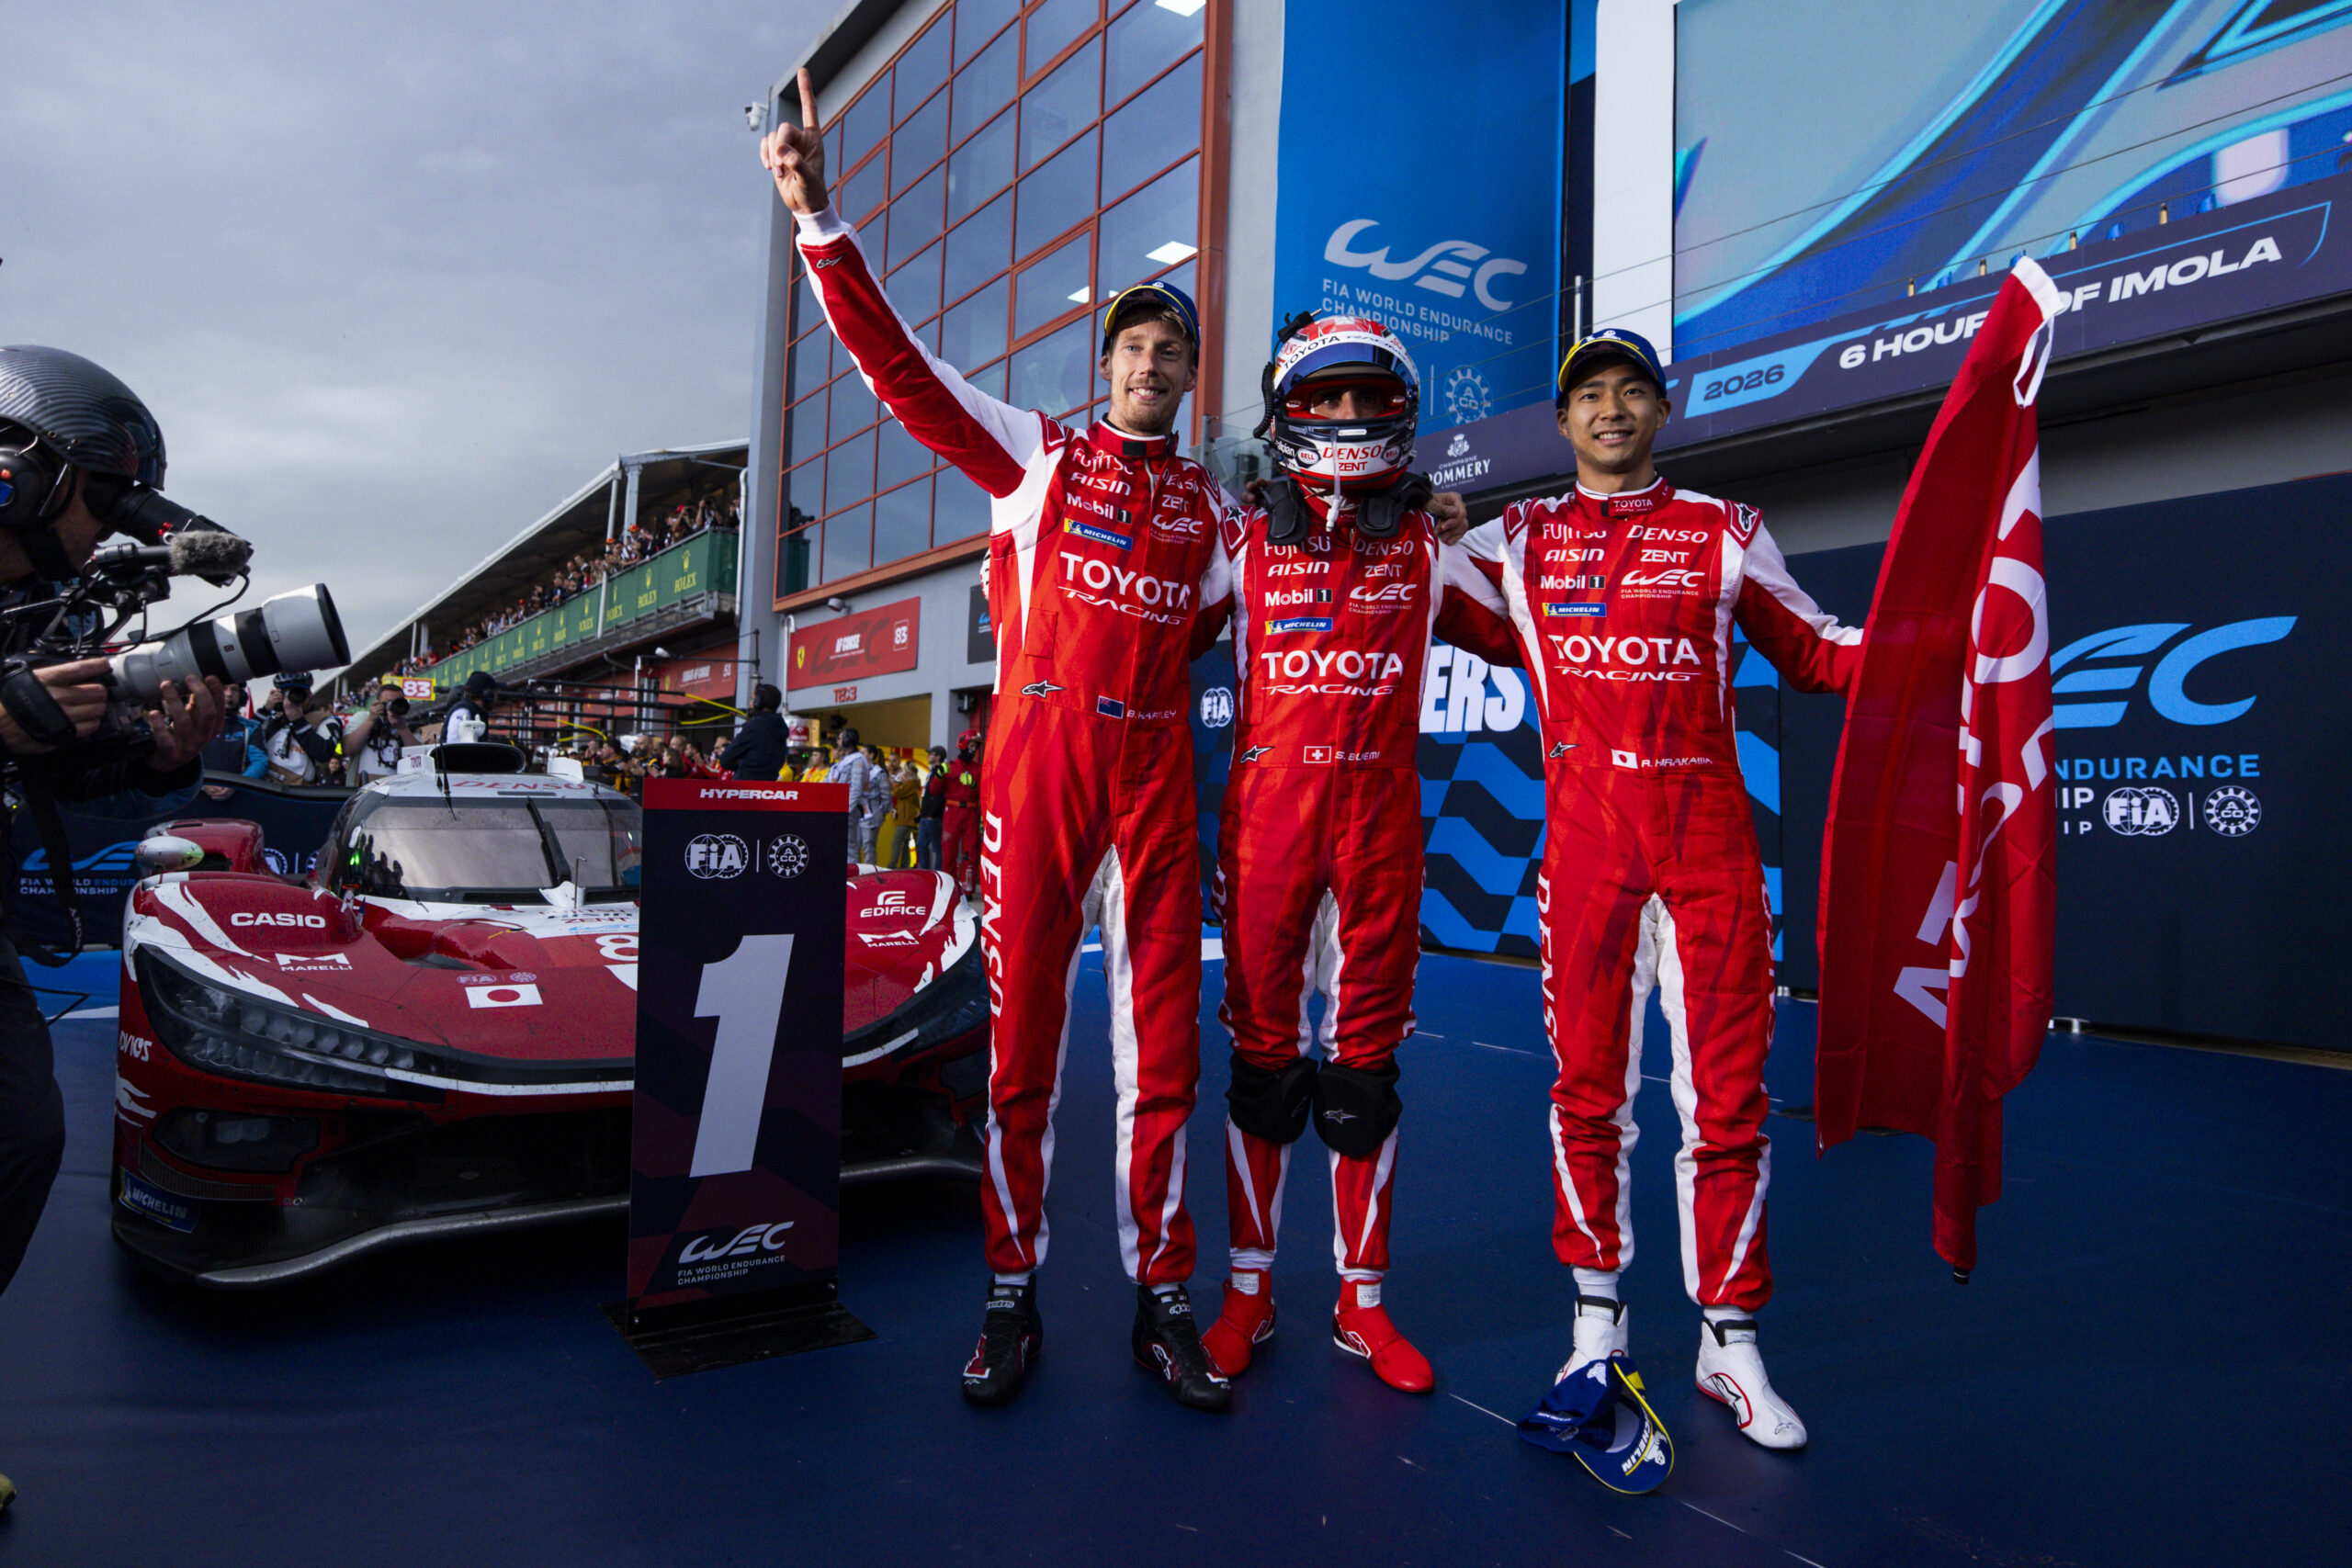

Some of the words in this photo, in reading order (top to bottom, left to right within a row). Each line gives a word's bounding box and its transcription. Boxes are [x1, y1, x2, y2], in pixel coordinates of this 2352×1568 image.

[1324, 219, 1528, 311] WEC
[1323, 278, 1350, 299] FIA
[1356, 288, 1416, 317] WORLD
[1419, 308, 1513, 345] ENDURANCE
[1839, 344, 1866, 369] 6
[1871, 310, 1990, 362] HOUR
[2109, 236, 2282, 303] IMOLA
[1703, 364, 1784, 401] 2026
[1300, 452, 1315, 460] BELL
[1323, 445, 1382, 460] DENSO
[1339, 461, 1368, 471] ZENT
[1070, 472, 1131, 496] AISIN
[1067, 492, 1114, 520] Mobil
[1613, 499, 1654, 509] TOYOTA
[1152, 513, 1204, 535] WEC
[1083, 528, 1127, 546] MICHELIN
[1626, 525, 1708, 544] DENSO
[1353, 537, 1414, 557] DENSO
[1544, 548, 1605, 562] AISIN
[1640, 549, 1690, 564] ZENT
[1267, 561, 1329, 577] AISIN
[1364, 564, 1403, 578] ZENT
[1621, 569, 1705, 588] WEC
[1059, 551, 1191, 610] TOYOTA
[1541, 575, 1586, 590] Mobil
[1265, 588, 1313, 607] Mobil
[1350, 582, 1418, 602] WEC
[1057, 586, 1188, 625] RACING
[894, 626, 908, 645] 83
[1547, 634, 1702, 666] TOYOTA
[1261, 649, 1404, 680] TOYOTA
[1554, 665, 1702, 682] RACING
[2050, 615, 2298, 729] EC
[403, 681, 431, 698] 83
[1261, 683, 1399, 696] RACING
[1335, 751, 1346, 761] S.
[1641, 759, 1653, 768] R.
[2055, 754, 2261, 780] NDURANCE
[453, 781, 587, 792] DENSO
[699, 788, 799, 801] HYPERCAR
[20, 878, 41, 886] FIA
[230, 912, 326, 929] CASIO
[860, 906, 926, 918] EDIFICE
[594, 933, 640, 963] 8
[867, 940, 919, 948] MARELLI
[690, 933, 795, 1179] 1
[129, 1190, 187, 1221] MICHELIN
[678, 1221, 794, 1264] WEC
[677, 1269, 693, 1278] FIA
[695, 1263, 729, 1276] WORLD
[730, 1255, 786, 1270] ENDURANCE
[677, 1269, 749, 1286] CHAMPIONSHIP
